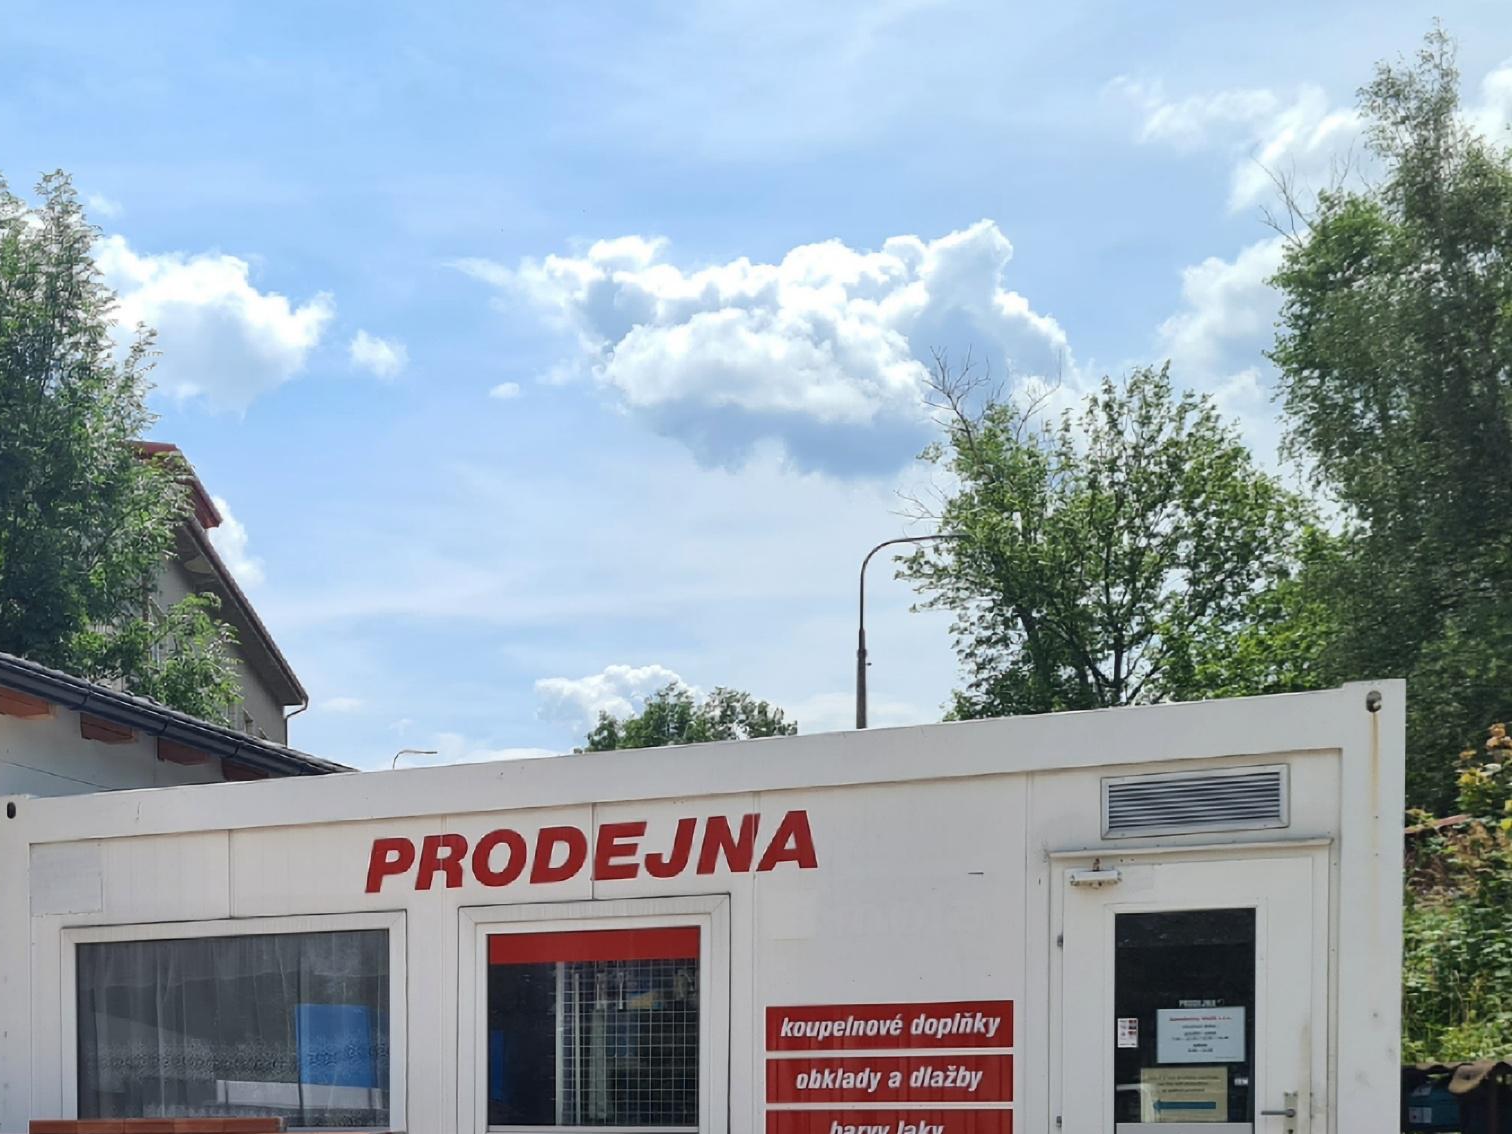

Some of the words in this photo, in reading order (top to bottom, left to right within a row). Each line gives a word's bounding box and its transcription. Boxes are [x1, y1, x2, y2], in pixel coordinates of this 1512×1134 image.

[365, 809, 818, 893] PRODEJNA
[781, 1014, 903, 1041] koupelnové
[911, 1012, 1000, 1038] doplňky
[796, 1068, 881, 1092] obklady
[888, 1071, 901, 1088] a
[910, 1065, 983, 1091] dlažby
